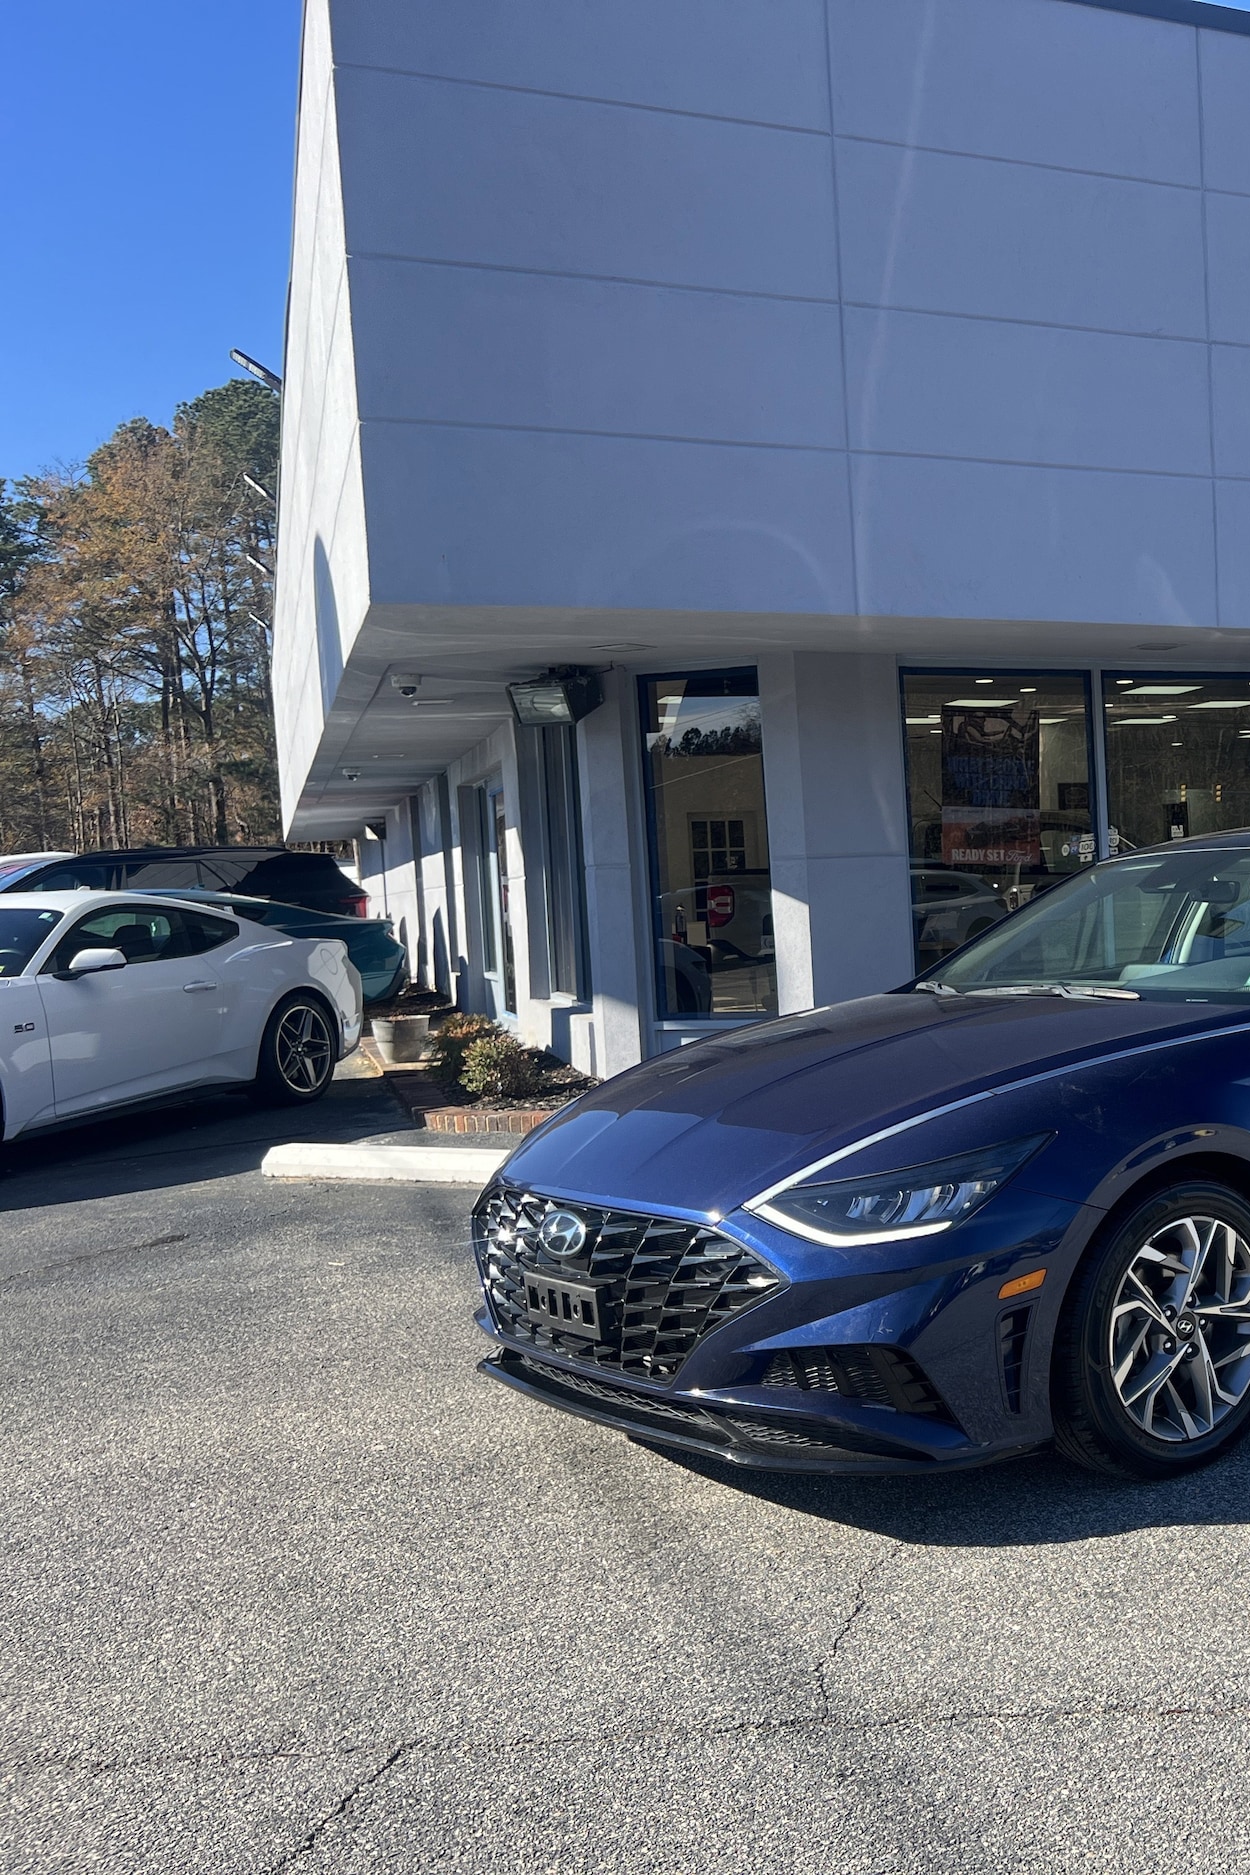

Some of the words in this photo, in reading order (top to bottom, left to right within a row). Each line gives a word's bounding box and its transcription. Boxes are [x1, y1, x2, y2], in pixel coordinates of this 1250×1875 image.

[952, 848, 985, 861] READY
[986, 849, 1005, 862] SET
[1006, 849, 1033, 863] Ford
